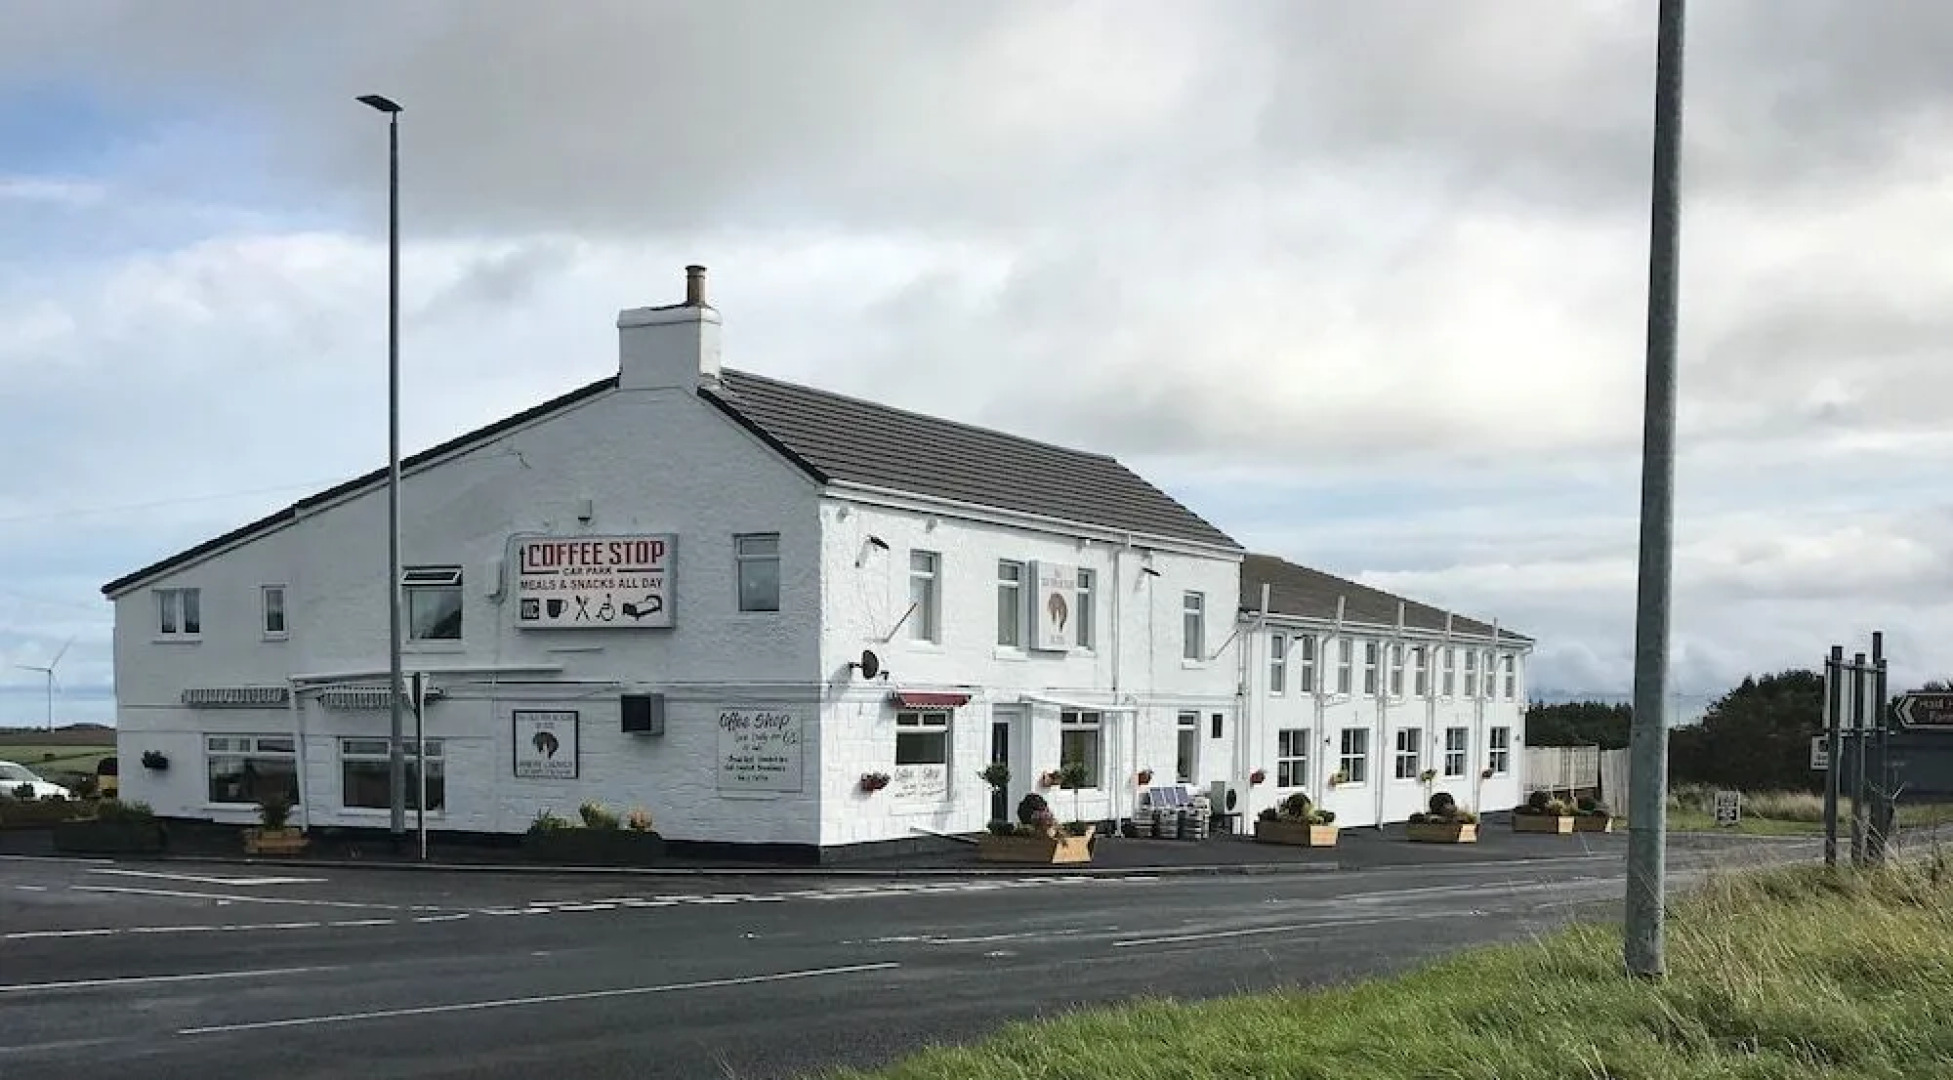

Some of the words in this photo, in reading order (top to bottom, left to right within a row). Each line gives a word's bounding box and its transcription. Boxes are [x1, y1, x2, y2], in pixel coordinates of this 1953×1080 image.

[528, 542, 603, 566] COFFEE
[609, 541, 664, 564] STOP
[562, 568, 584, 576] CAR
[586, 567, 612, 575] PARK
[520, 579, 556, 590] MEALS
[560, 579, 567, 589] &
[570, 578, 614, 589] SNACKS
[619, 577, 639, 588] ALL
[642, 577, 663, 588] DAY
[719, 712, 750, 732] Coffee
[754, 712, 790, 731] Shop
